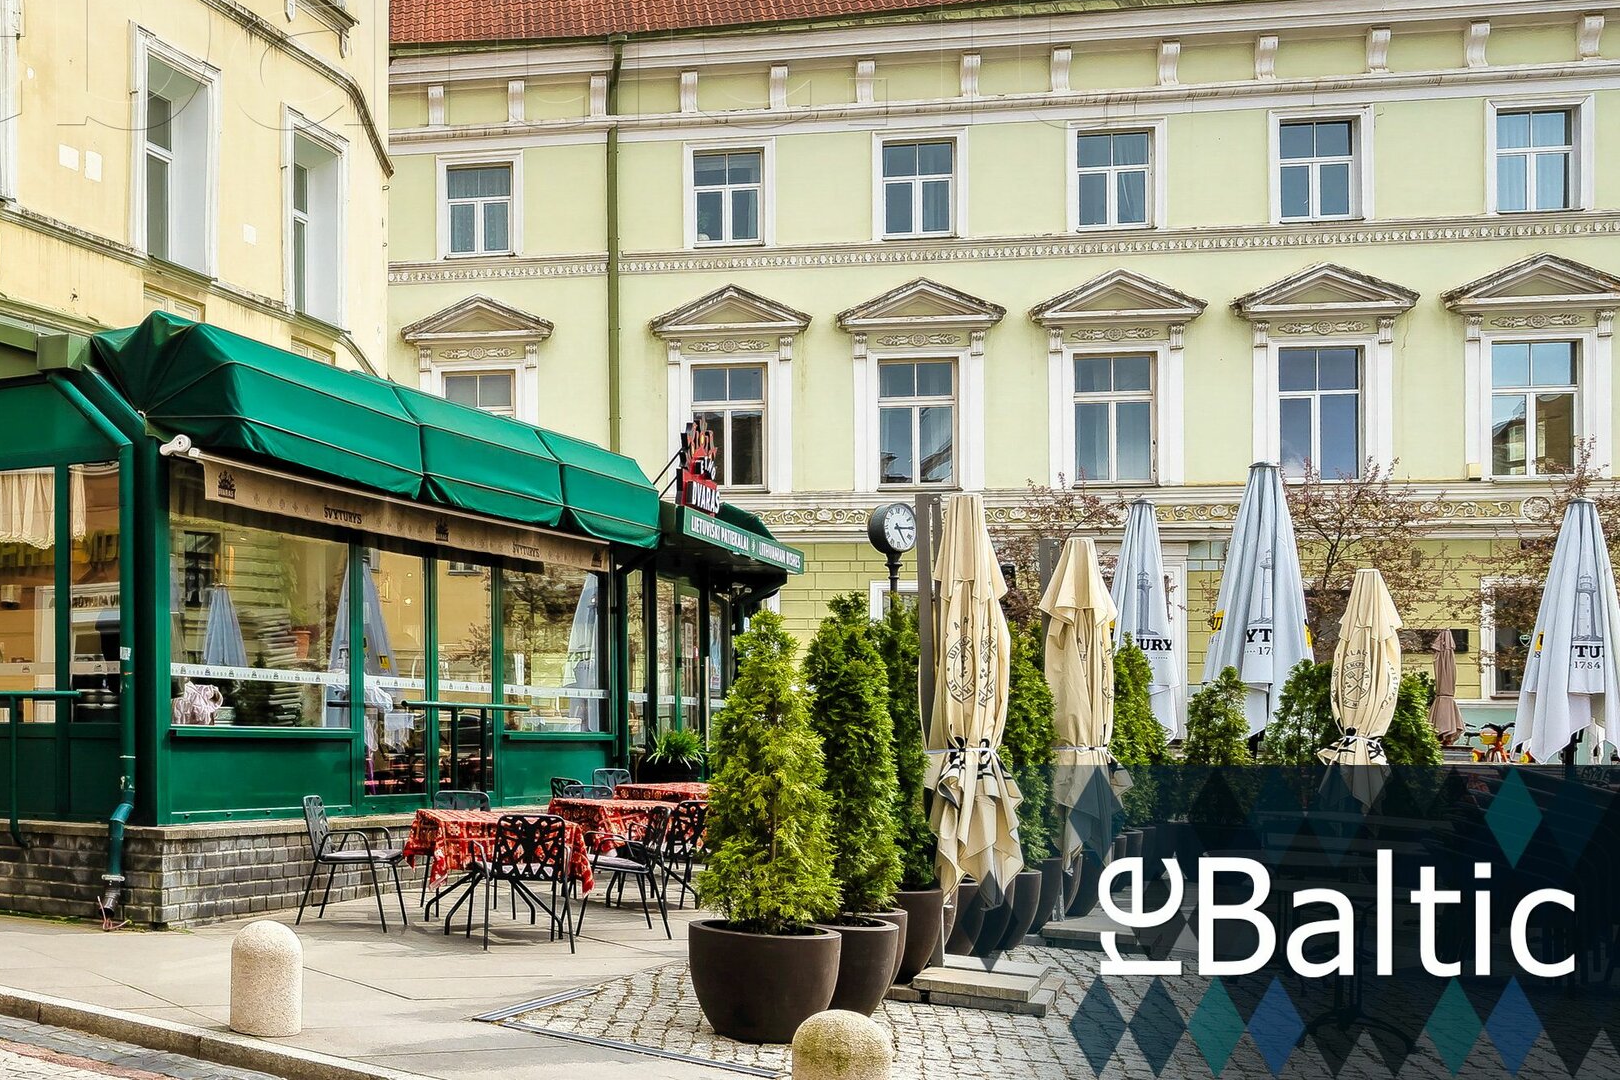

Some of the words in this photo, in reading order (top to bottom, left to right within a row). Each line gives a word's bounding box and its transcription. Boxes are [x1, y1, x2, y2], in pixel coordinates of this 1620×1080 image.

[692, 481, 720, 514] DVARAS
[1571, 645, 1605, 658] TU
[1574, 661, 1601, 669] 1784
